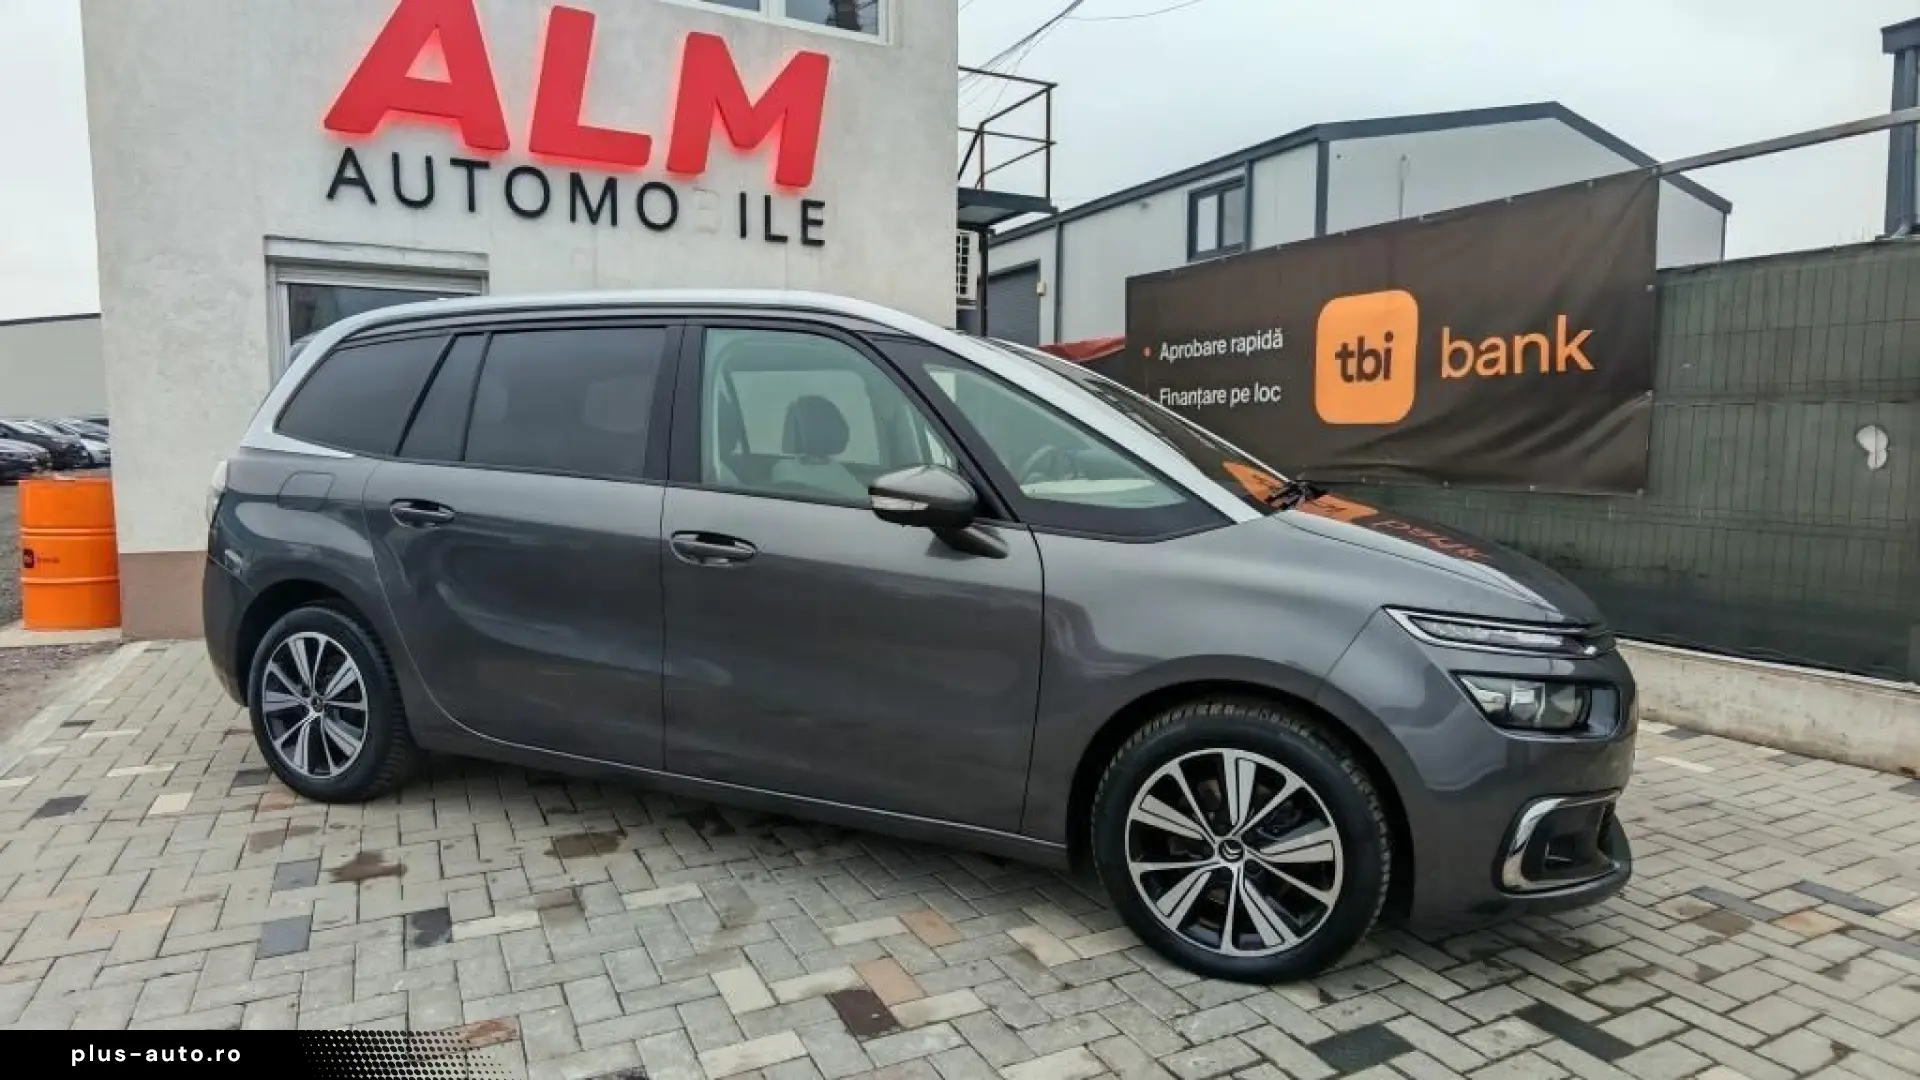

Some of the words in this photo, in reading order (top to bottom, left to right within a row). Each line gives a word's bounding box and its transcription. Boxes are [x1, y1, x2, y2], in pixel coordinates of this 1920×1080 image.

[323, 0, 830, 188] ALM
[326, 147, 826, 248] AUTOMOILE
[1159, 338, 1227, 365] Aprobare
[1231, 327, 1284, 357] rapidă
[1334, 331, 1394, 384] tbi
[1441, 314, 1594, 379] bank
[1159, 387, 1227, 410] Finanțare
[1229, 387, 1250, 408] pe
[1254, 381, 1282, 403] loc
